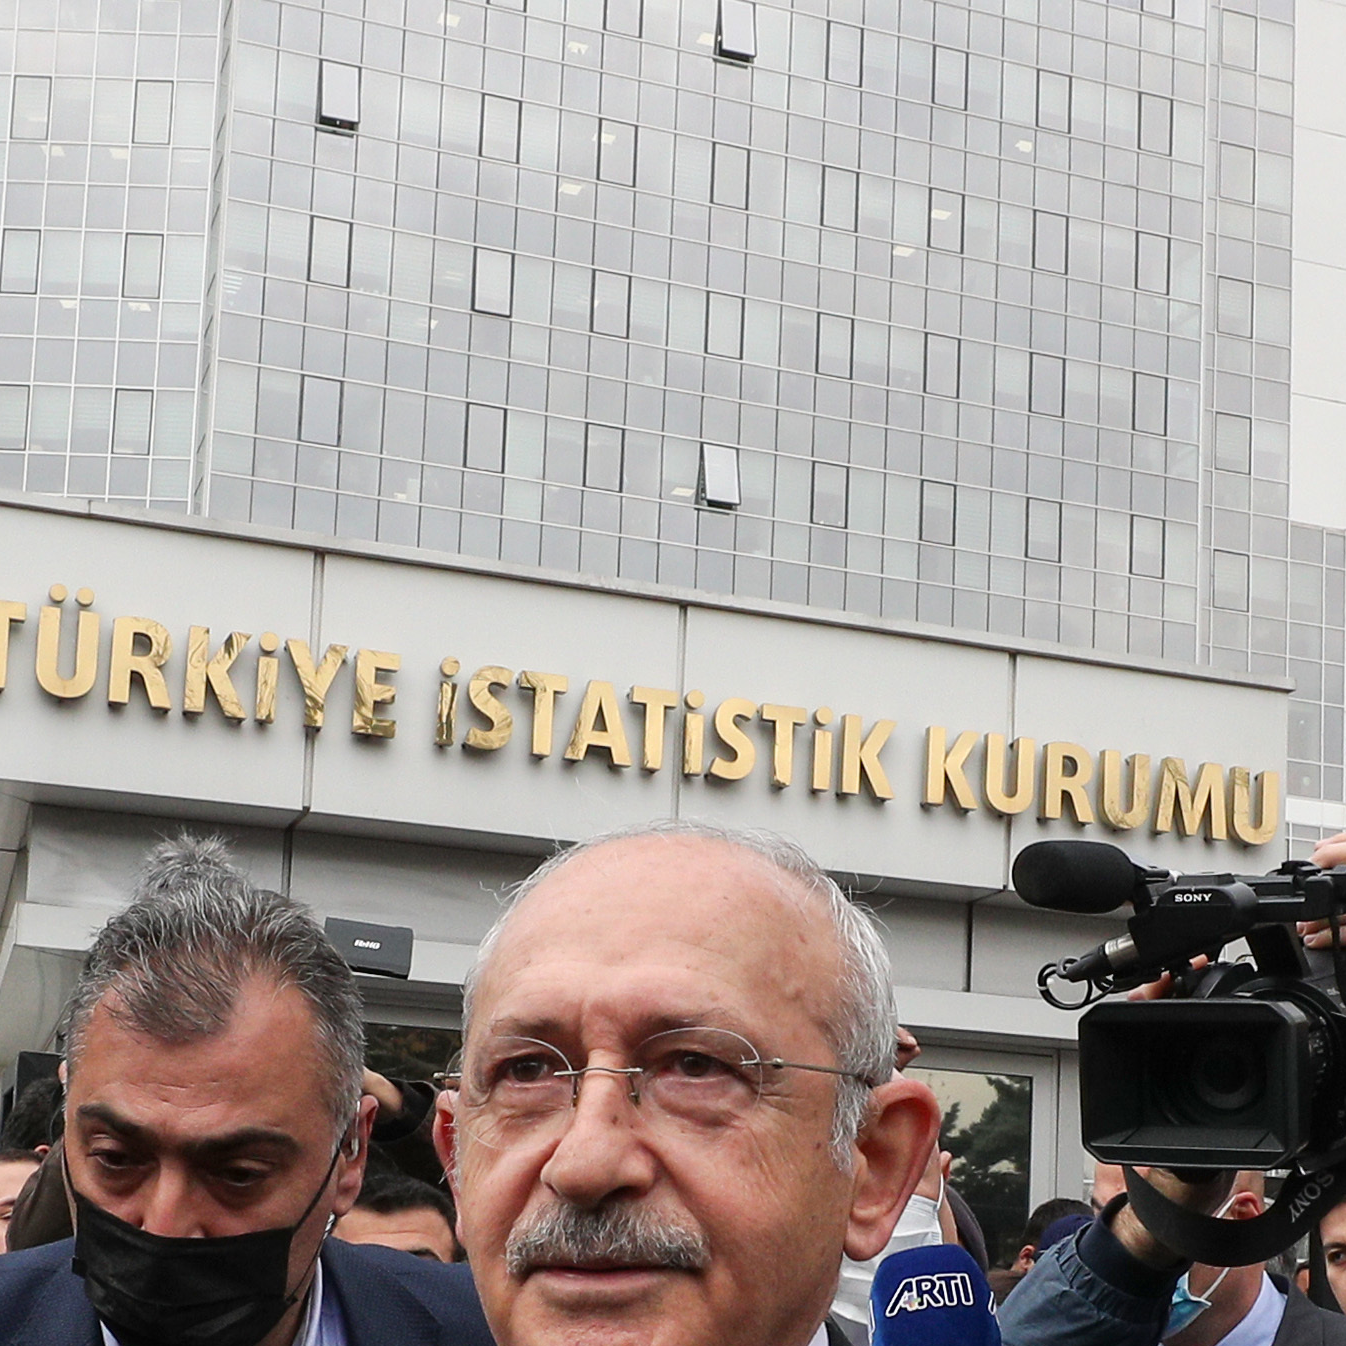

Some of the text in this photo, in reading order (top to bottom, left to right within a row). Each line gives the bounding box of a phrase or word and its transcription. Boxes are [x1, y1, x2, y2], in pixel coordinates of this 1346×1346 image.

[920, 724, 1281, 847] KURUMU
[1174, 892, 1212, 903] SONY
[1288, 1173, 1335, 1223] SONY
[885, 1273, 974, 1317] ARTI
